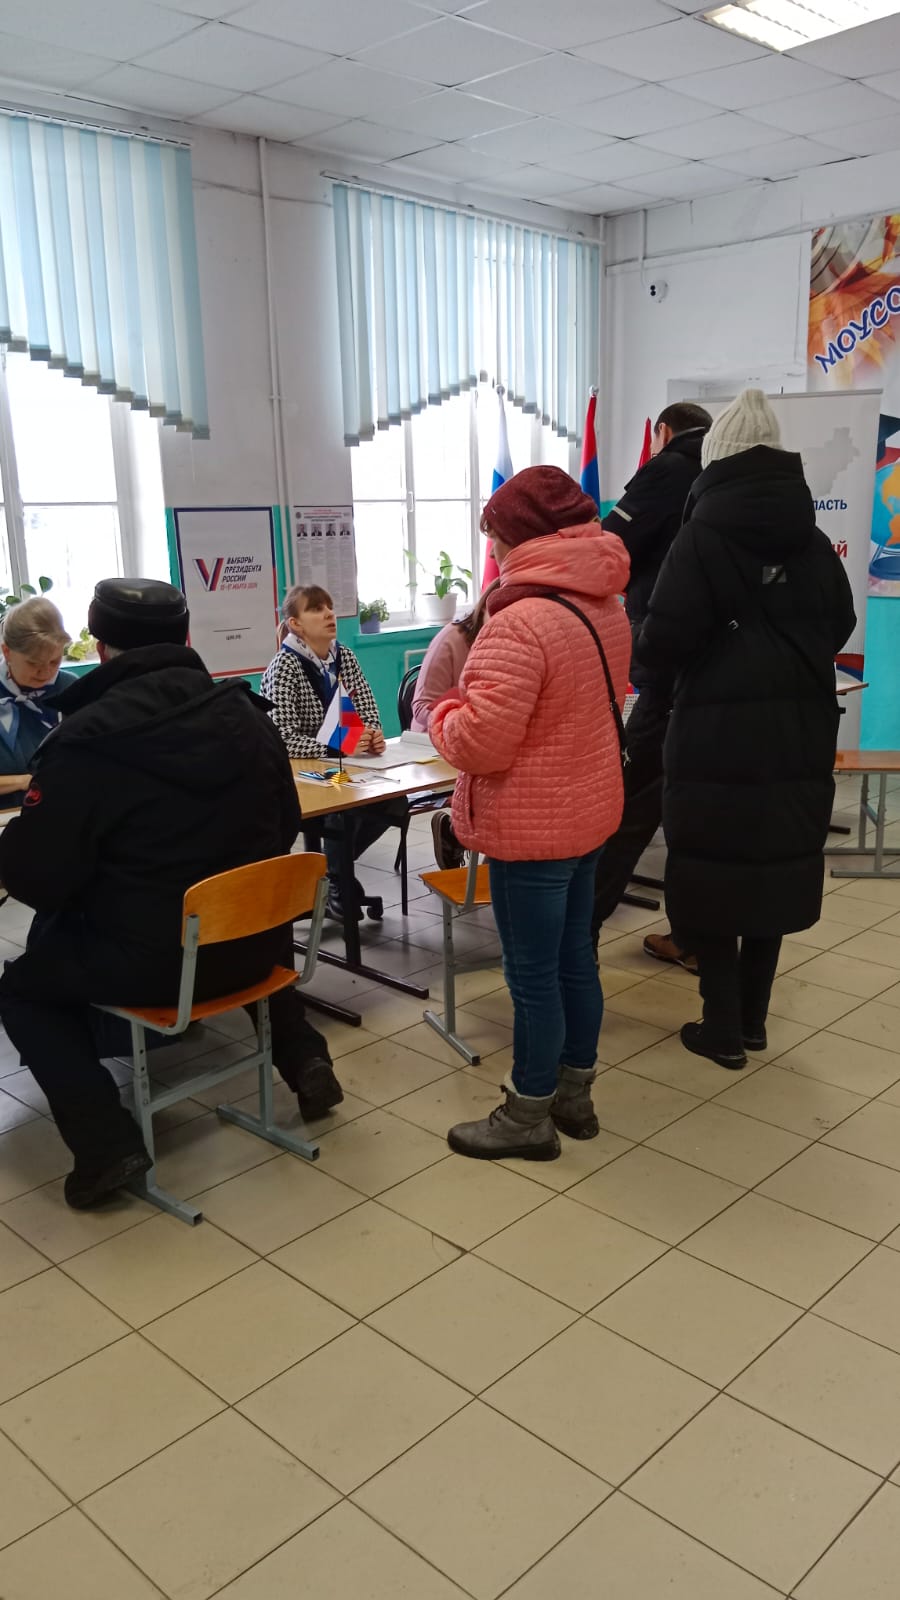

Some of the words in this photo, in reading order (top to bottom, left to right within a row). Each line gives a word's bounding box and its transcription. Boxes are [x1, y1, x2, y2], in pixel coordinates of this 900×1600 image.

[226, 556, 254, 564] ВЫБОРЫ
[224, 564, 262, 573] ПРЕЗИДЕНТА
[222, 575, 247, 583] РОССИИ
